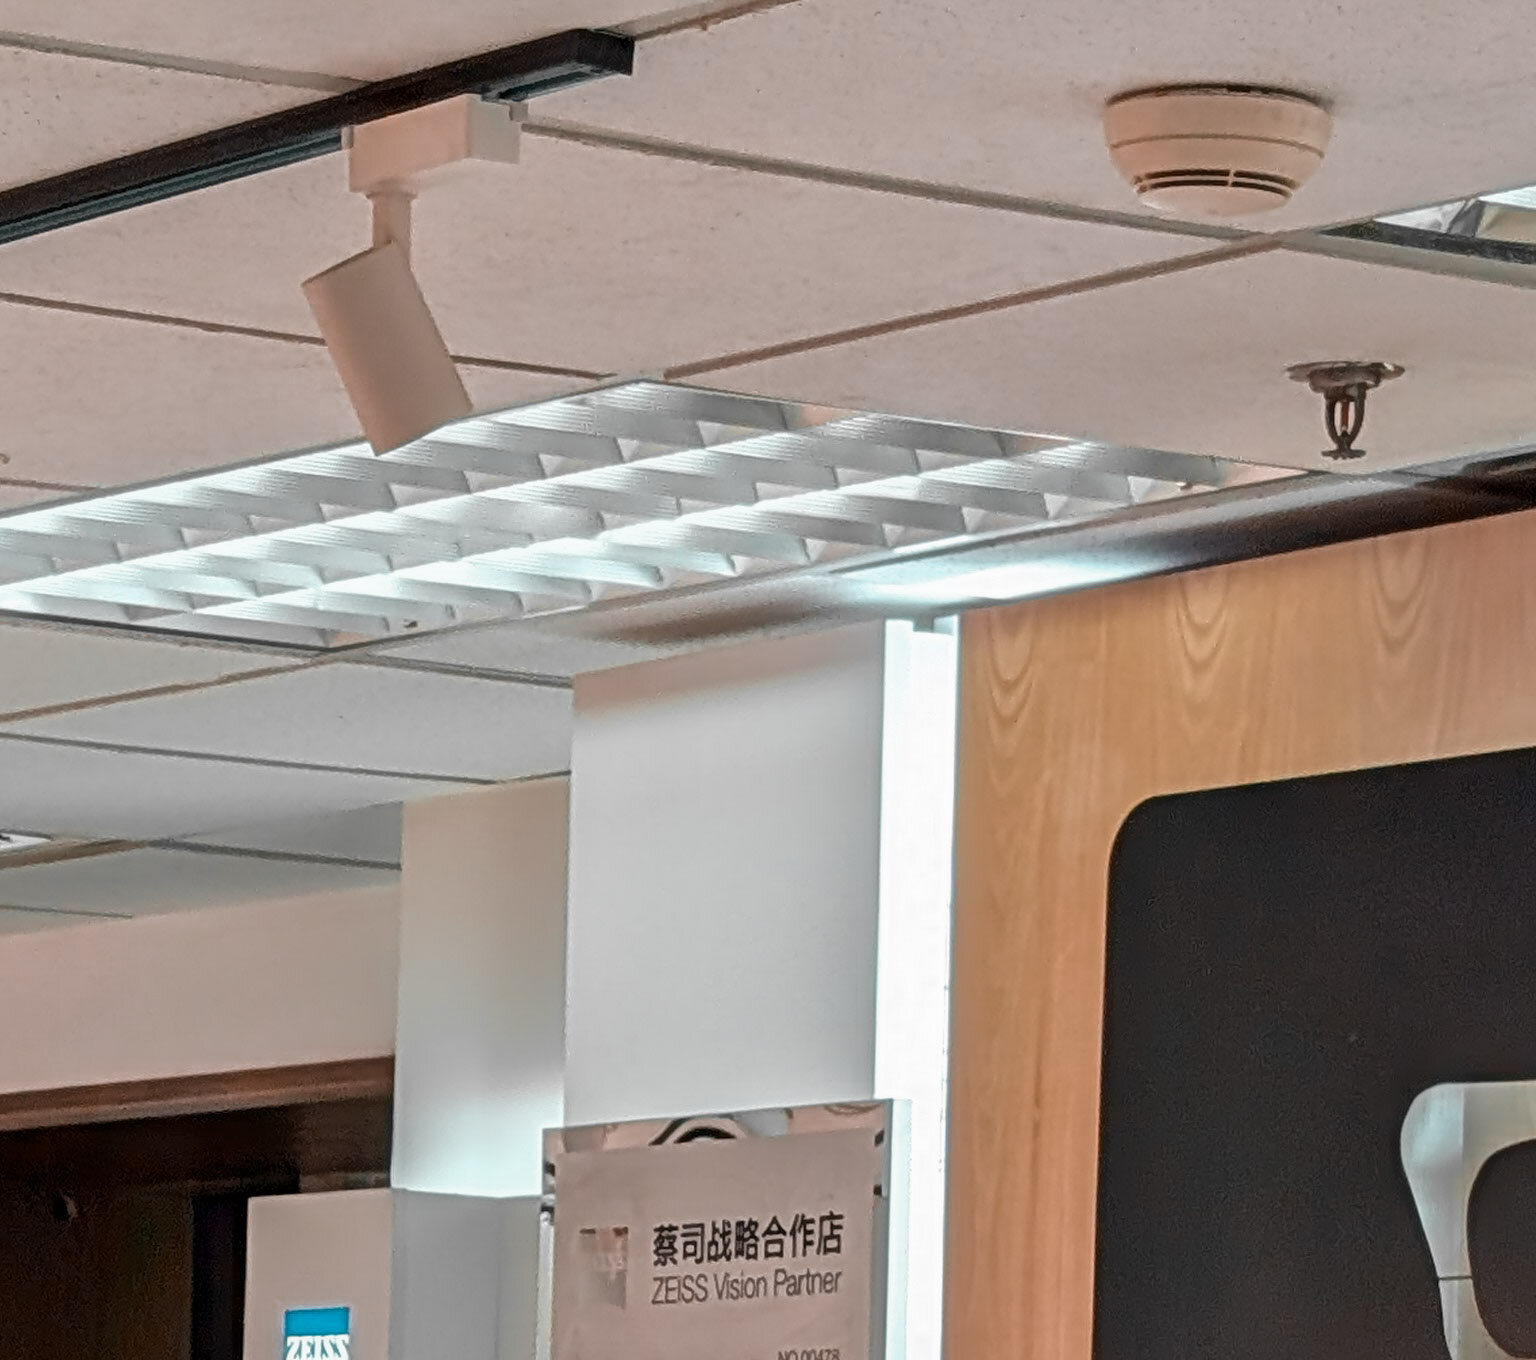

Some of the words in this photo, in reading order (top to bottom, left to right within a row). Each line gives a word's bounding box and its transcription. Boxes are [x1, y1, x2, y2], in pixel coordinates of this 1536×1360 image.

[653, 1211, 844, 1267] 蔡司战略合作店
[652, 1273, 709, 1305] ZEISS
[713, 1269, 768, 1301] Vision
[773, 1267, 843, 1297] Partner
